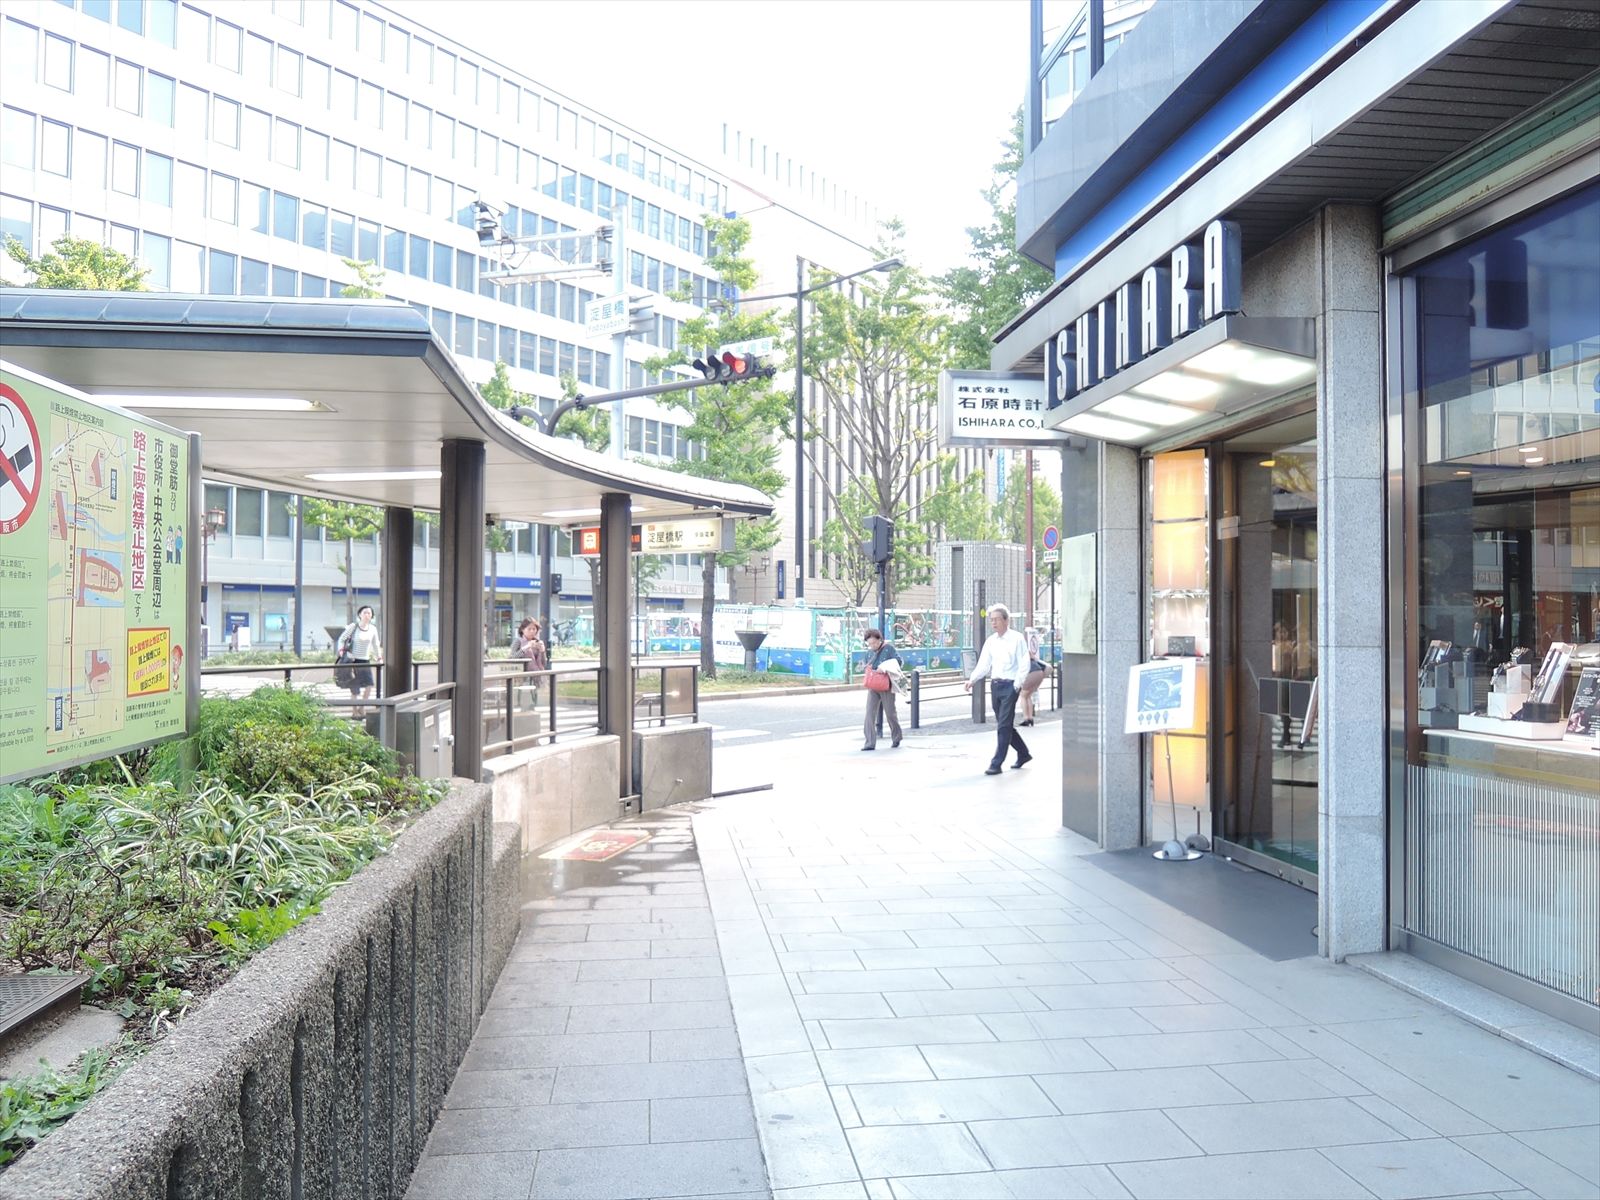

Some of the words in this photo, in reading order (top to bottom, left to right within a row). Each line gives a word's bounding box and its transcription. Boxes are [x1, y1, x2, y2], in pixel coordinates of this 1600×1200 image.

[590, 299, 625, 322] 淀屋橋
[1044, 219, 1241, 411] ISHIHARA
[958, 386, 1010, 394] 株式会社
[958, 417, 1016, 428] ISHIHARA
[647, 530, 684, 543] 淀屋橋駅
